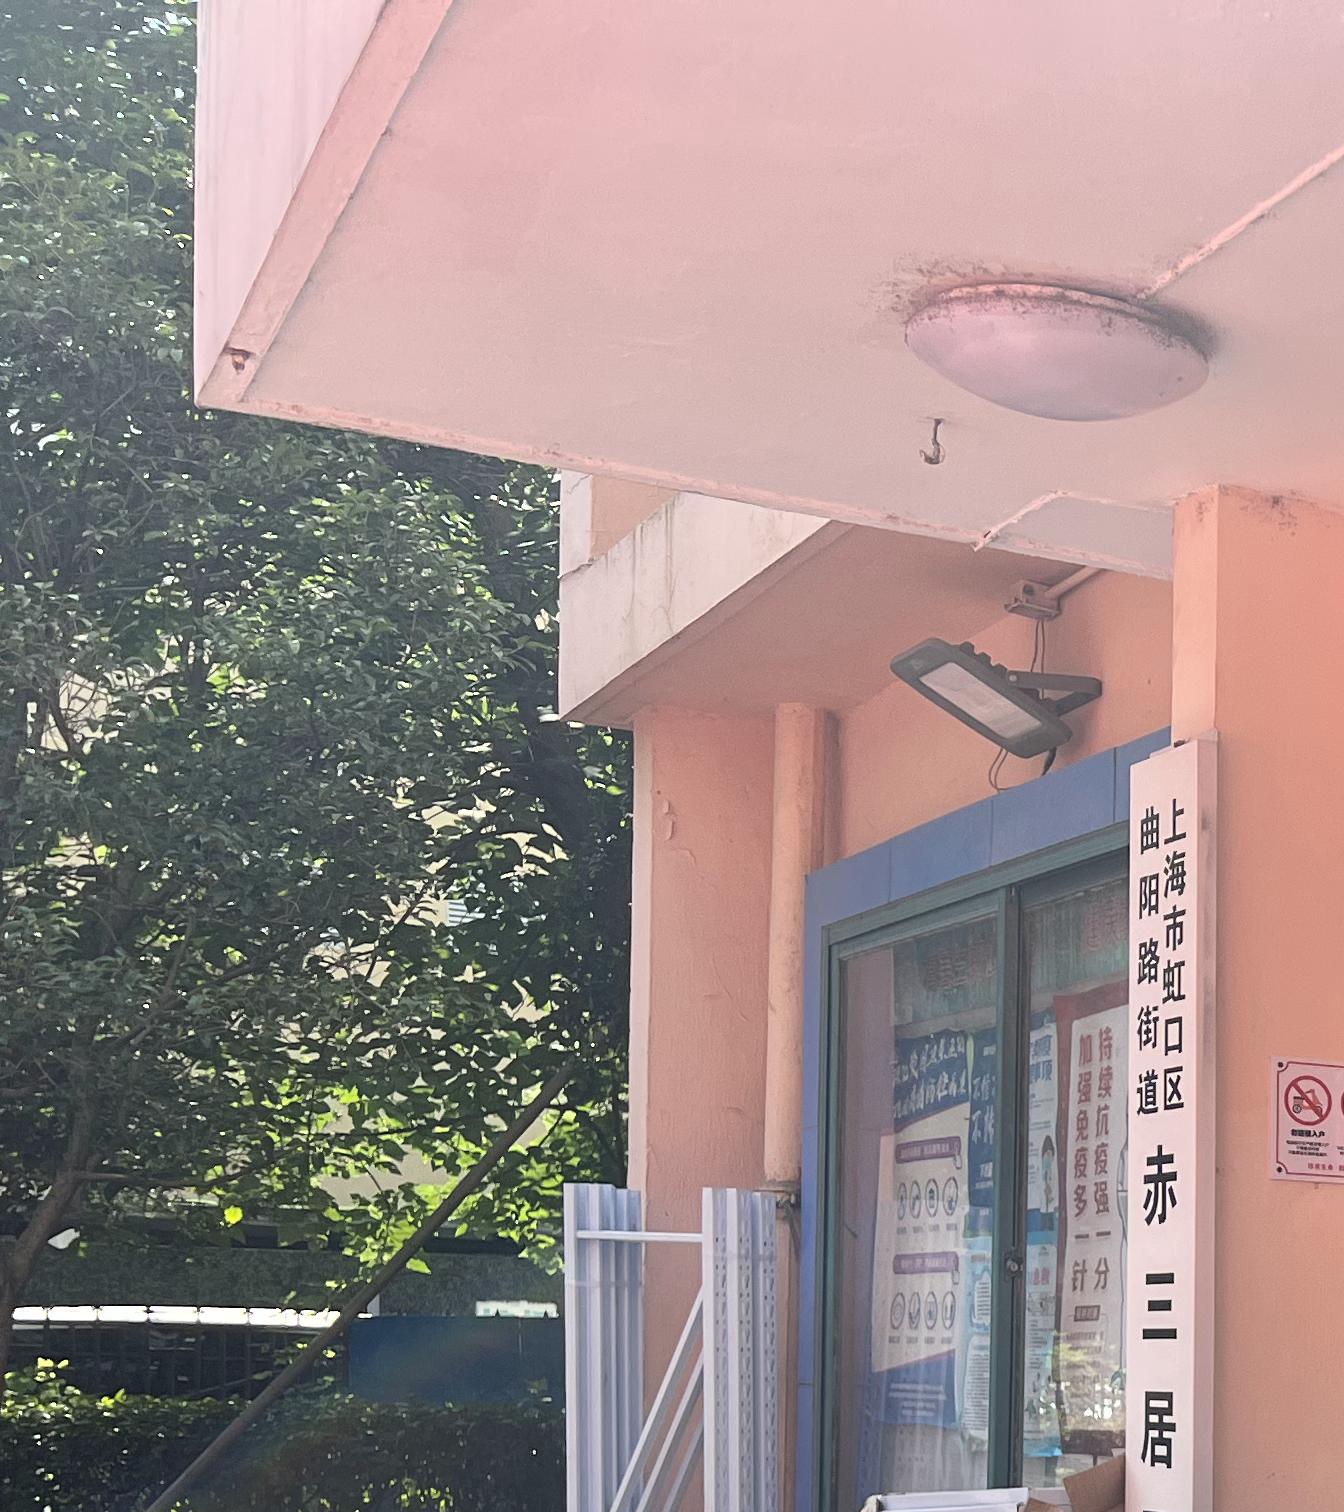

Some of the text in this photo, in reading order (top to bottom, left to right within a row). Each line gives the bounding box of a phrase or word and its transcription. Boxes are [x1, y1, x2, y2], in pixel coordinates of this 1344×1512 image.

[1136, 806, 1160, 1116] 曲阳路街道
[1163, 798, 1187, 1111] 上海市虹口区
